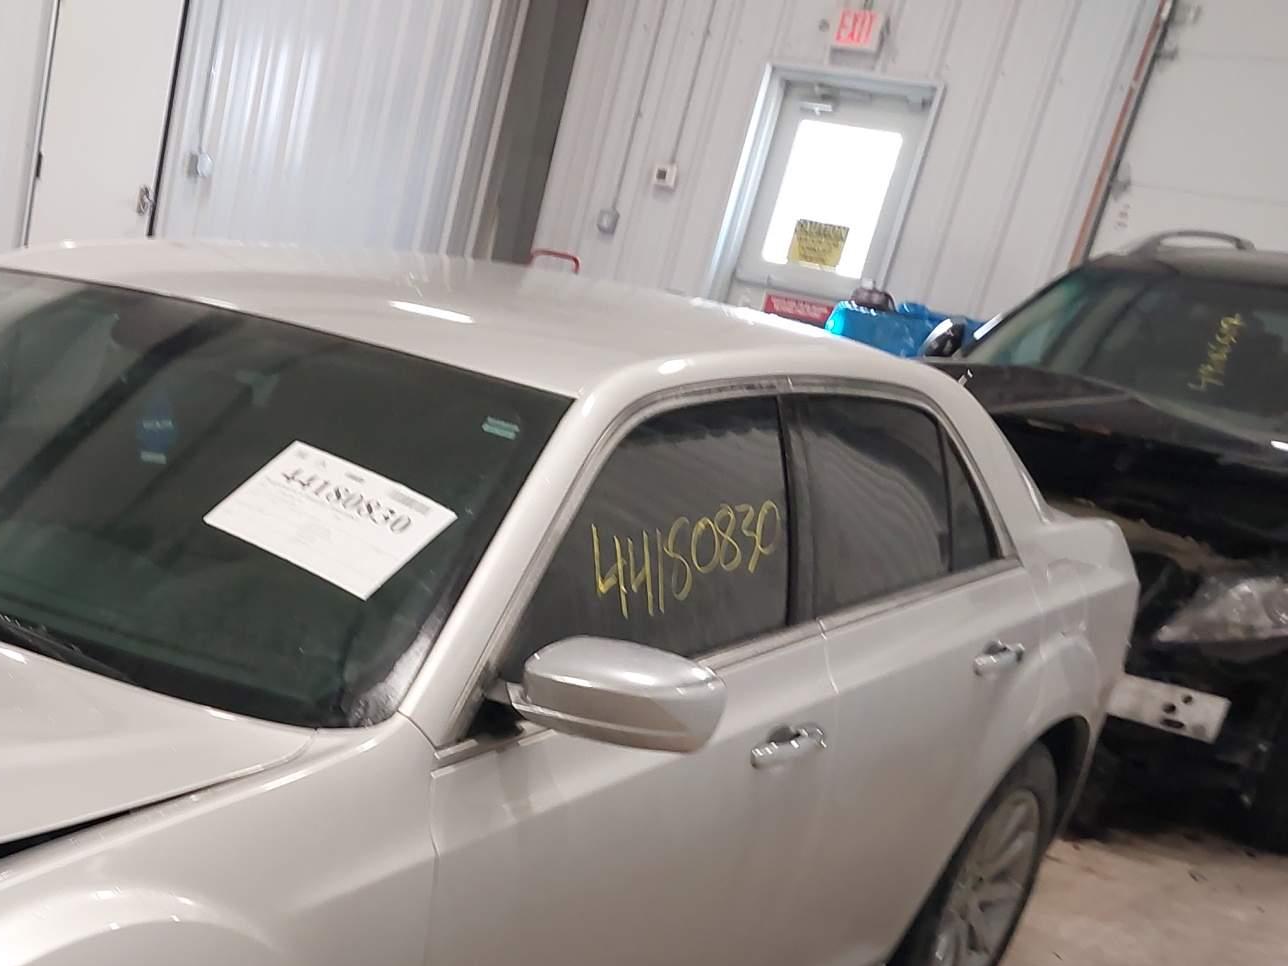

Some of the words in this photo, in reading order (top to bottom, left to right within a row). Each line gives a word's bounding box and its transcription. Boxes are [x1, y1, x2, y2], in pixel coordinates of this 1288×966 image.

[835, 9, 878, 46] EXIT
[282, 468, 412, 534] 44180830
[591, 499, 782, 620] 44180830
